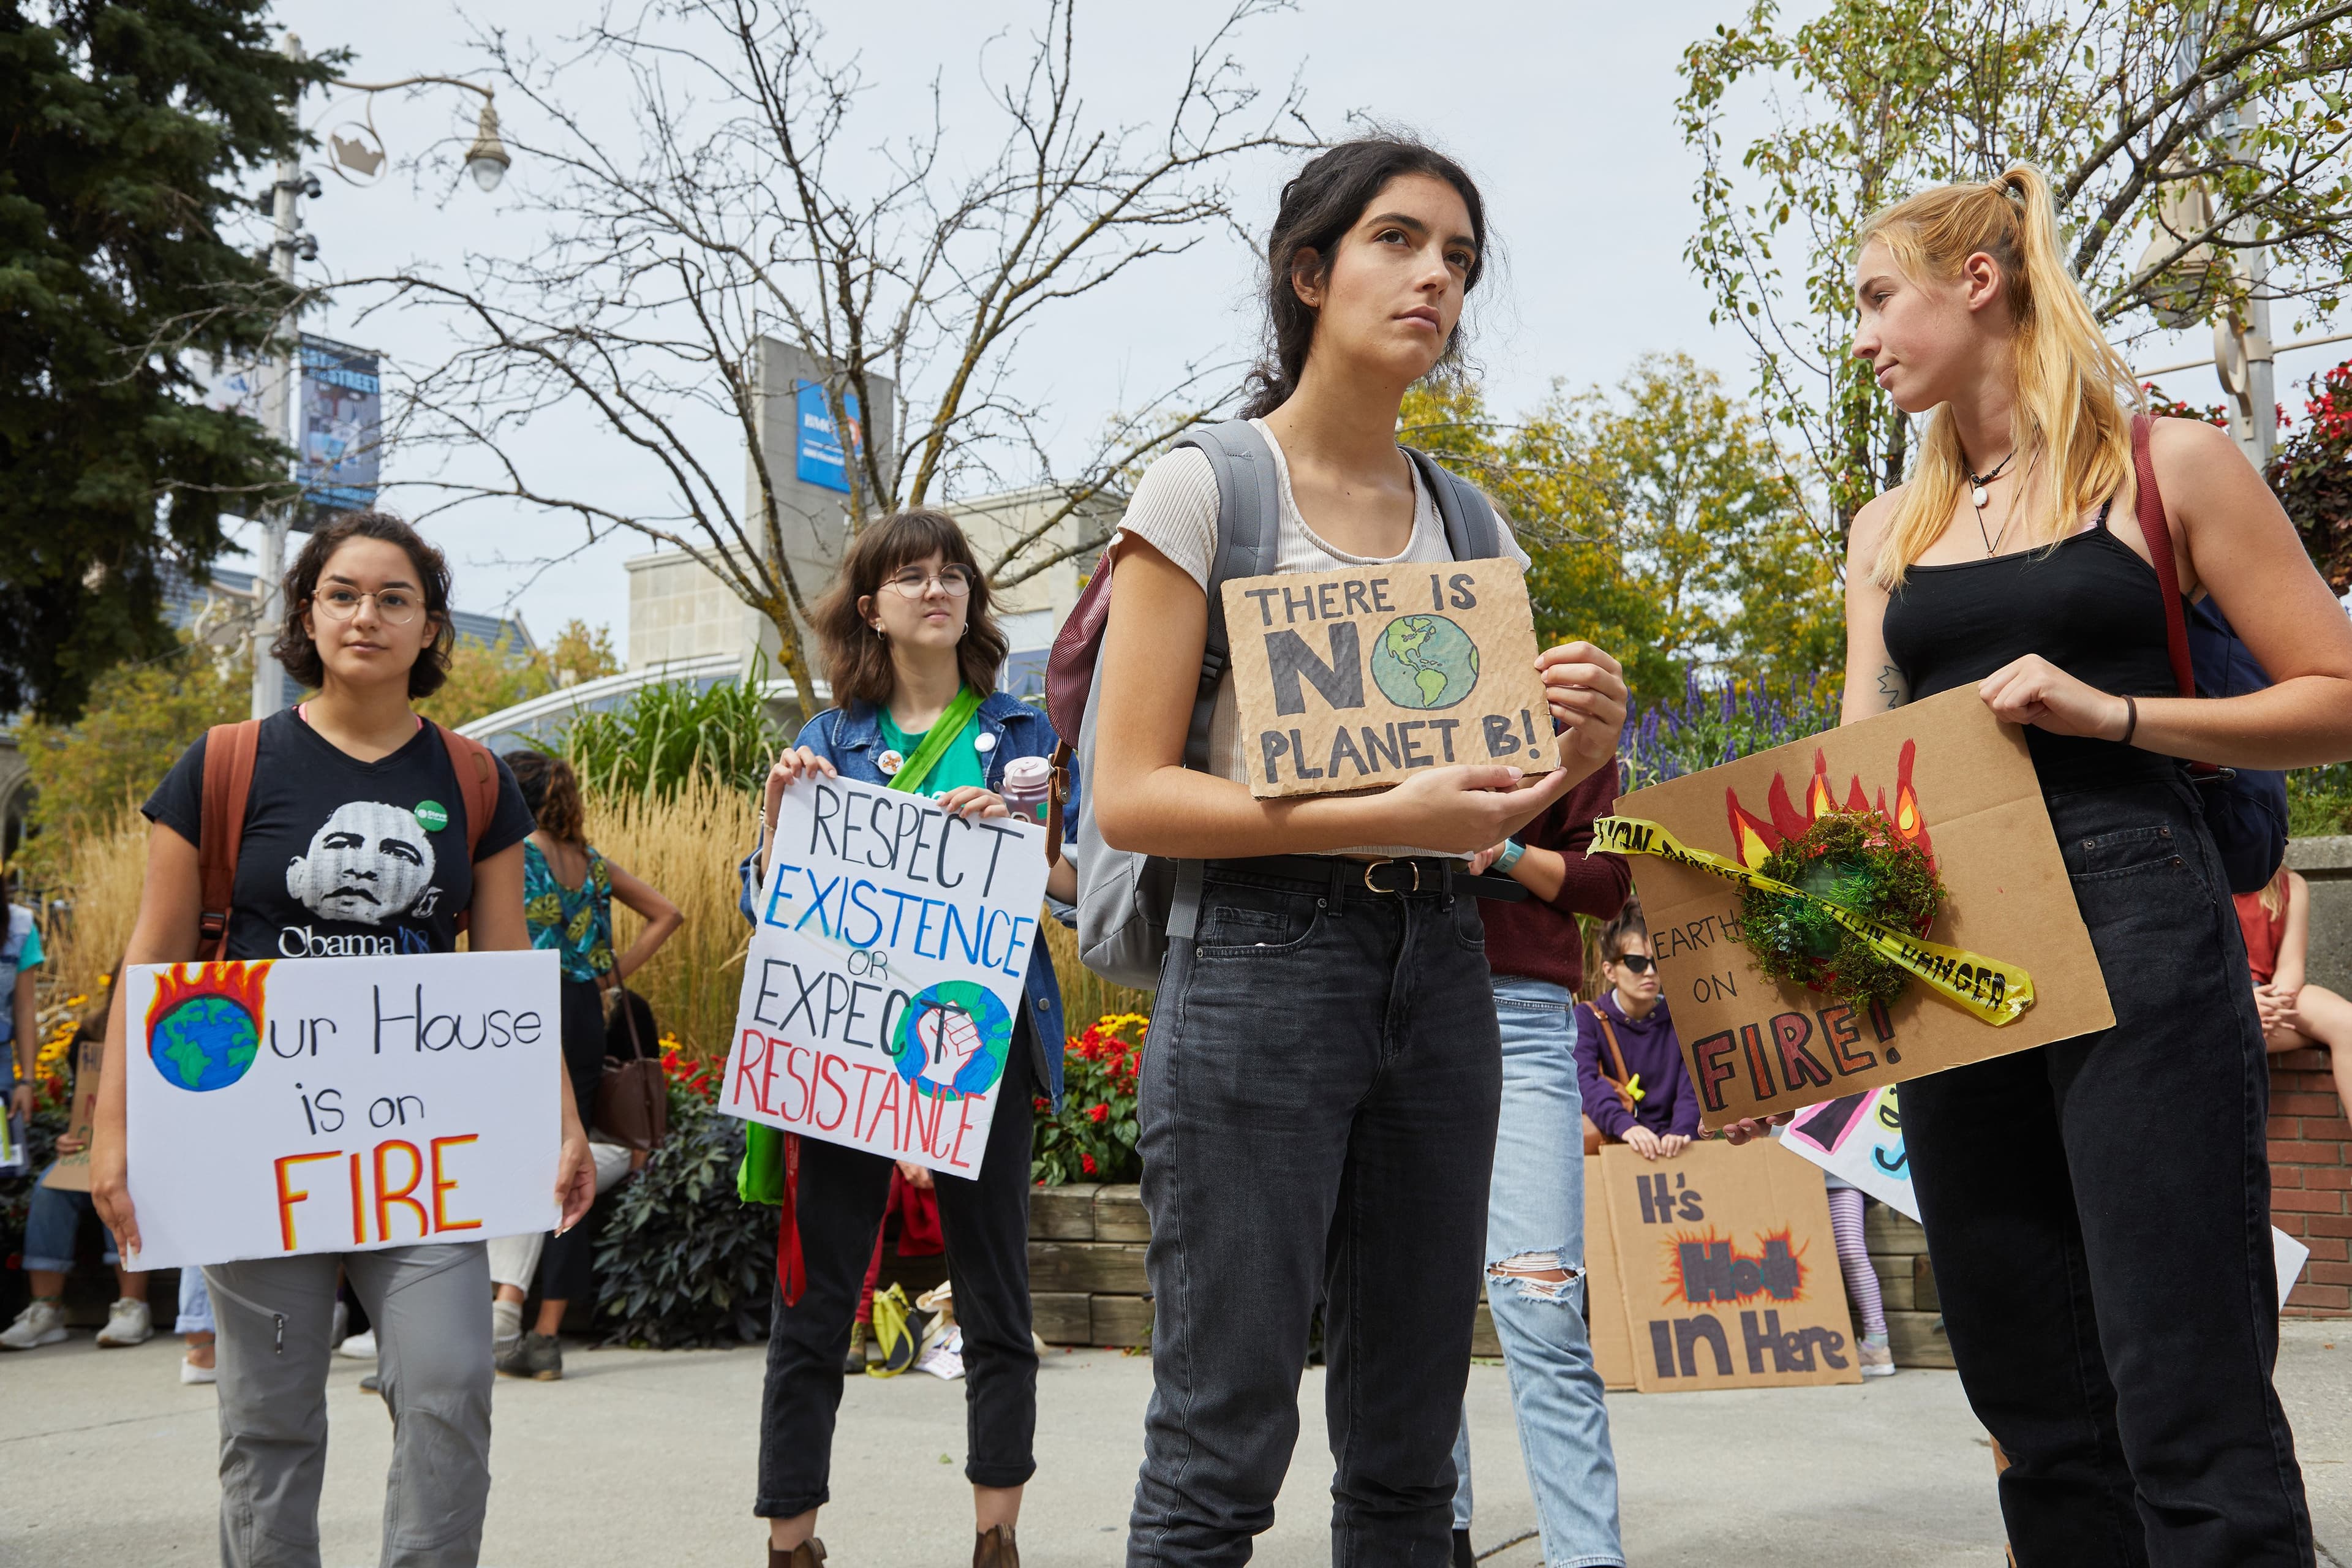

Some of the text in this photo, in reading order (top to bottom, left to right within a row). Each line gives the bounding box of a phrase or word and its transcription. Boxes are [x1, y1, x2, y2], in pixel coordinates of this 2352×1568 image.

[1245, 573, 1477, 626] THERE IS
[1260, 709, 1540, 783] PLANET B!
[810, 784, 1023, 897] RESPECT
[278, 925, 397, 958] Obama
[764, 864, 1034, 978] EXISTENCE
[1653, 909, 1740, 960] EARTH
[848, 949, 888, 980] OR
[1694, 971, 1738, 1003] ON
[373, 984, 541, 1055] House
[753, 959, 968, 1064] EXPECT
[1692, 1000, 1902, 1112] FIRE!
[295, 1082, 425, 1136] is on
[733, 1030, 987, 1167] RESISTANCE
[274, 1133, 483, 1251] FIRE
[1636, 1172, 1704, 1224] It's
[1679, 1240, 1801, 1303] Hot
[1740, 1310, 1849, 1375] Here
